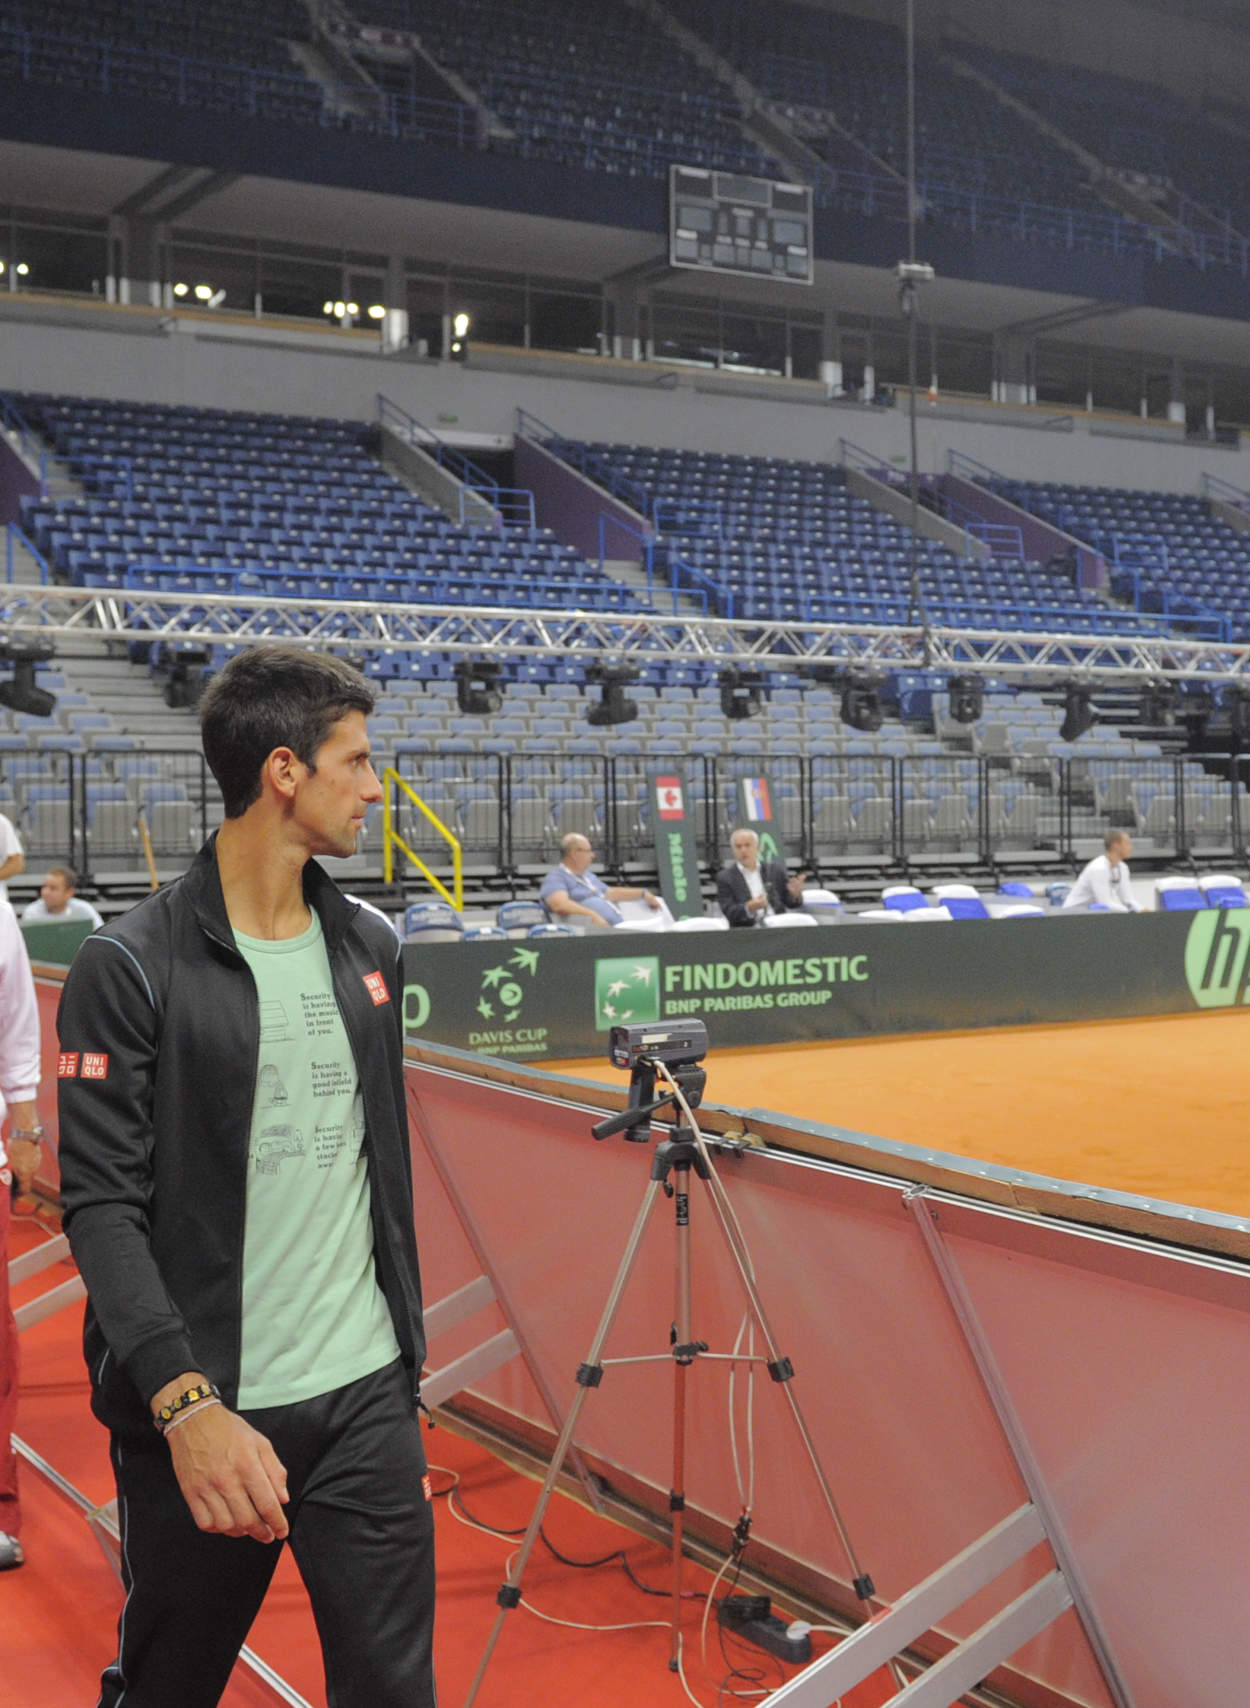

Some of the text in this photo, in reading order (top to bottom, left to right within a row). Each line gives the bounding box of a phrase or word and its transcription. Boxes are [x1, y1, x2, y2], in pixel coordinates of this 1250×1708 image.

[665, 955, 869, 992] FINDOMESTIC
[300, 992, 331, 1001] Security
[665, 990, 832, 1015] BNP PARIBAS GROUP
[469, 1028, 548, 1045] DAVIS CUP
[86, 1055, 105, 1065] UNI
[311, 1061, 340, 1069] Security
[84, 1066, 105, 1076] QLO
